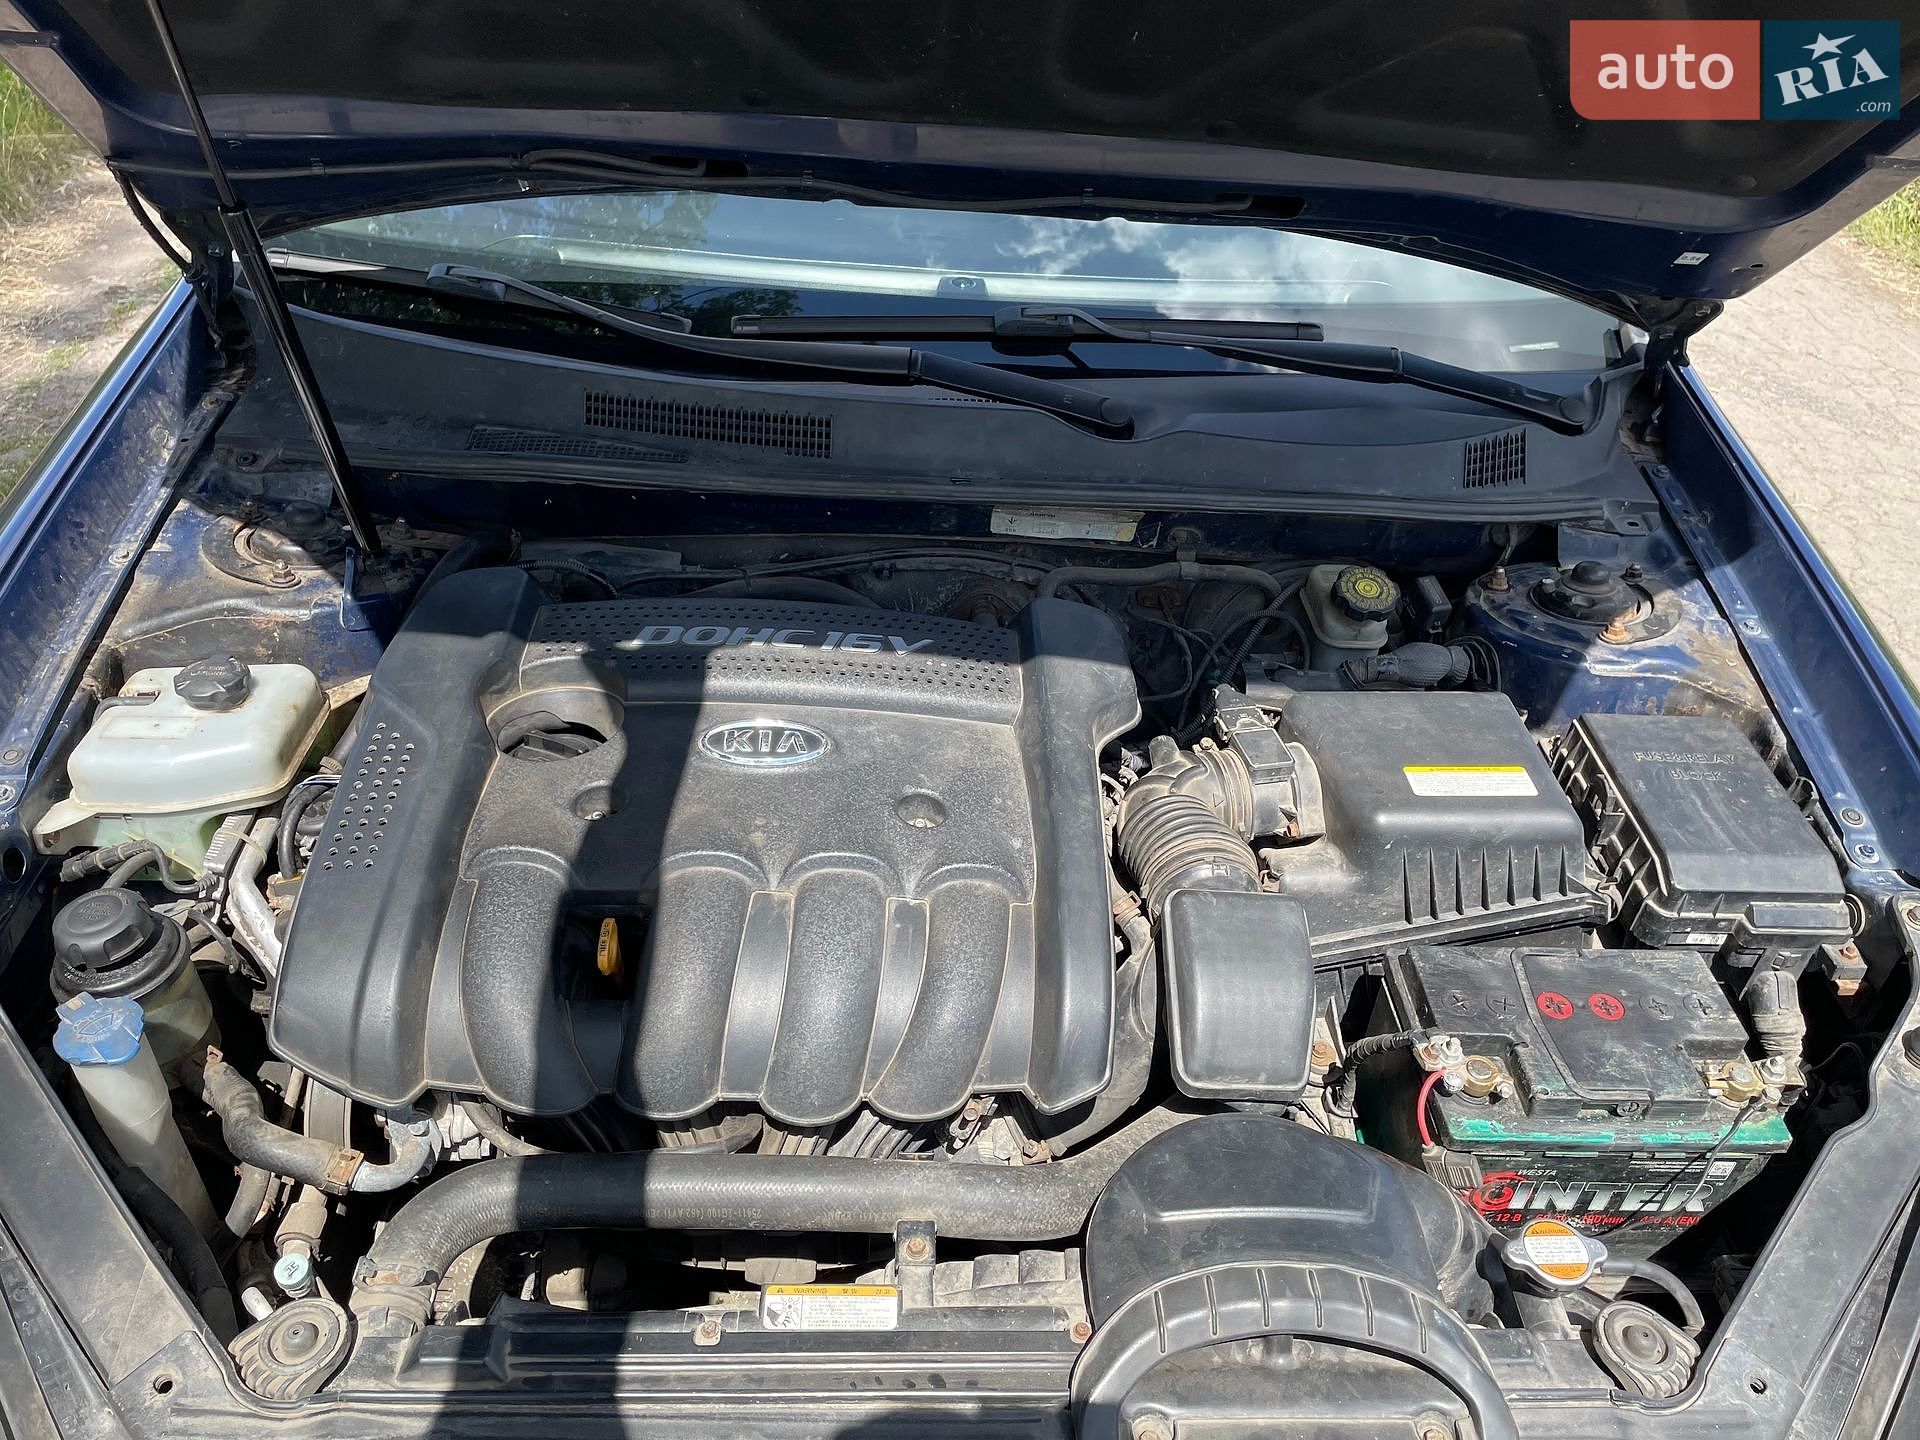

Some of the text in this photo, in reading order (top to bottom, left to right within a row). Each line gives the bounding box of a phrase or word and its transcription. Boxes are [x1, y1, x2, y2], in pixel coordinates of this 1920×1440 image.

[632, 626, 934, 656] DOHC 16V
[721, 729, 808, 753] KIA
[1669, 768, 1727, 781] BLOCK
[1508, 1180, 1714, 1211] INTER
[793, 1287, 828, 1295] WARNING
